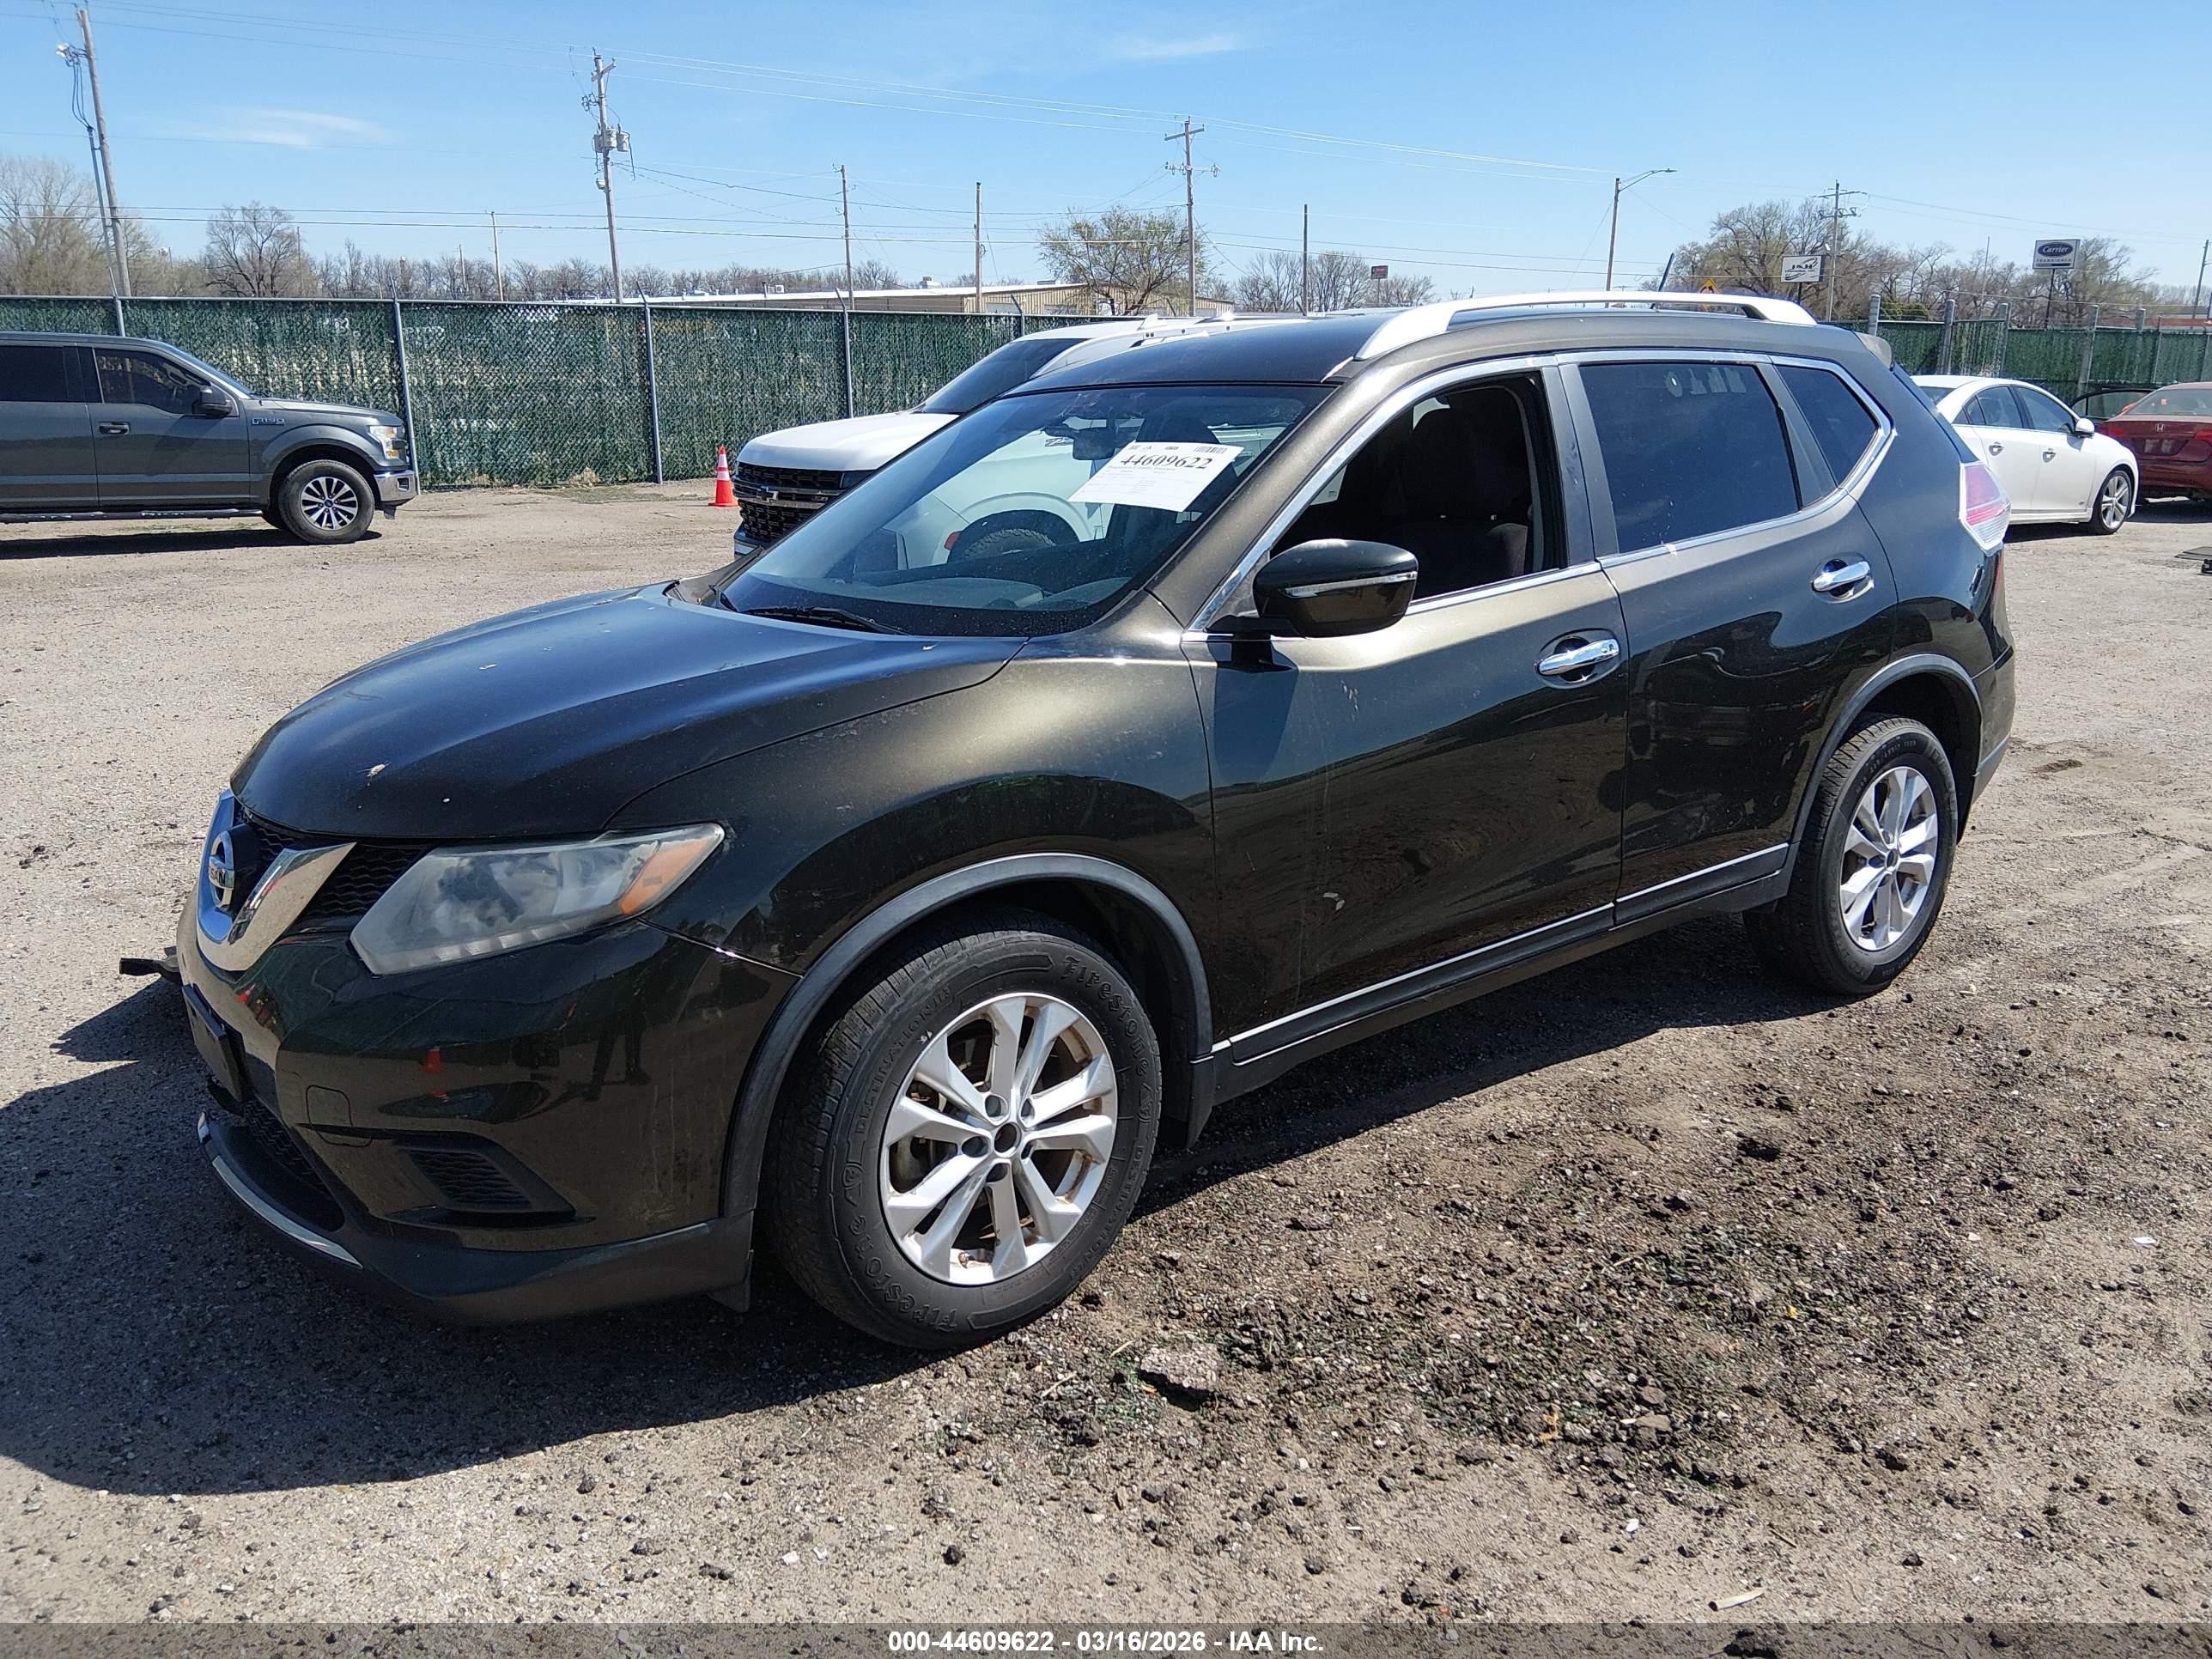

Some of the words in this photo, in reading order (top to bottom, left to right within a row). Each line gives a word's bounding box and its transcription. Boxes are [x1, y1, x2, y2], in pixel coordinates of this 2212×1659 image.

[1121, 454, 1212, 470] 44609622
[1061, 955, 1149, 1077] Firestone
[848, 1215, 957, 1332] Firestone
